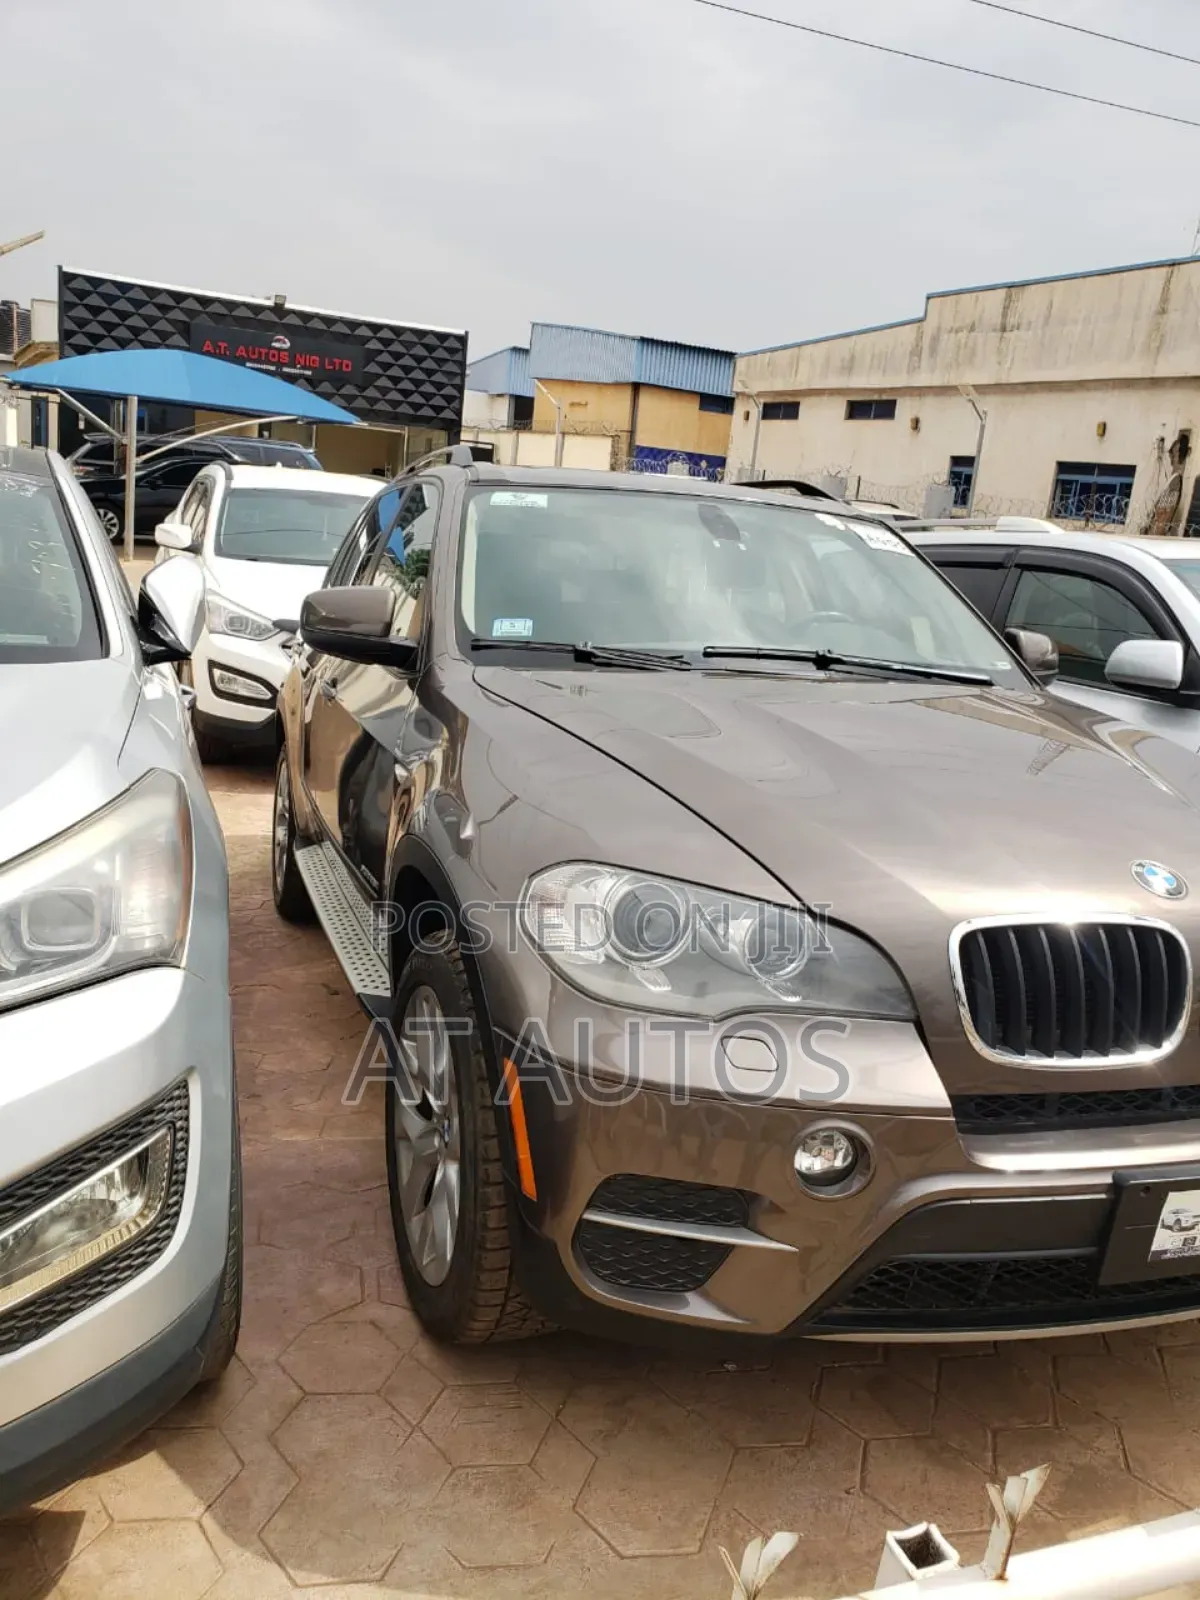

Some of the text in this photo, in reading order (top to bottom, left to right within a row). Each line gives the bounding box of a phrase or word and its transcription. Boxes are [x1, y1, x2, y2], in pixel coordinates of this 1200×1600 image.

[203, 340, 230, 356] A.T.
[236, 346, 289, 364] AUTOS
[295, 352, 320, 368] NIG
[325, 357, 352, 372] LTD
